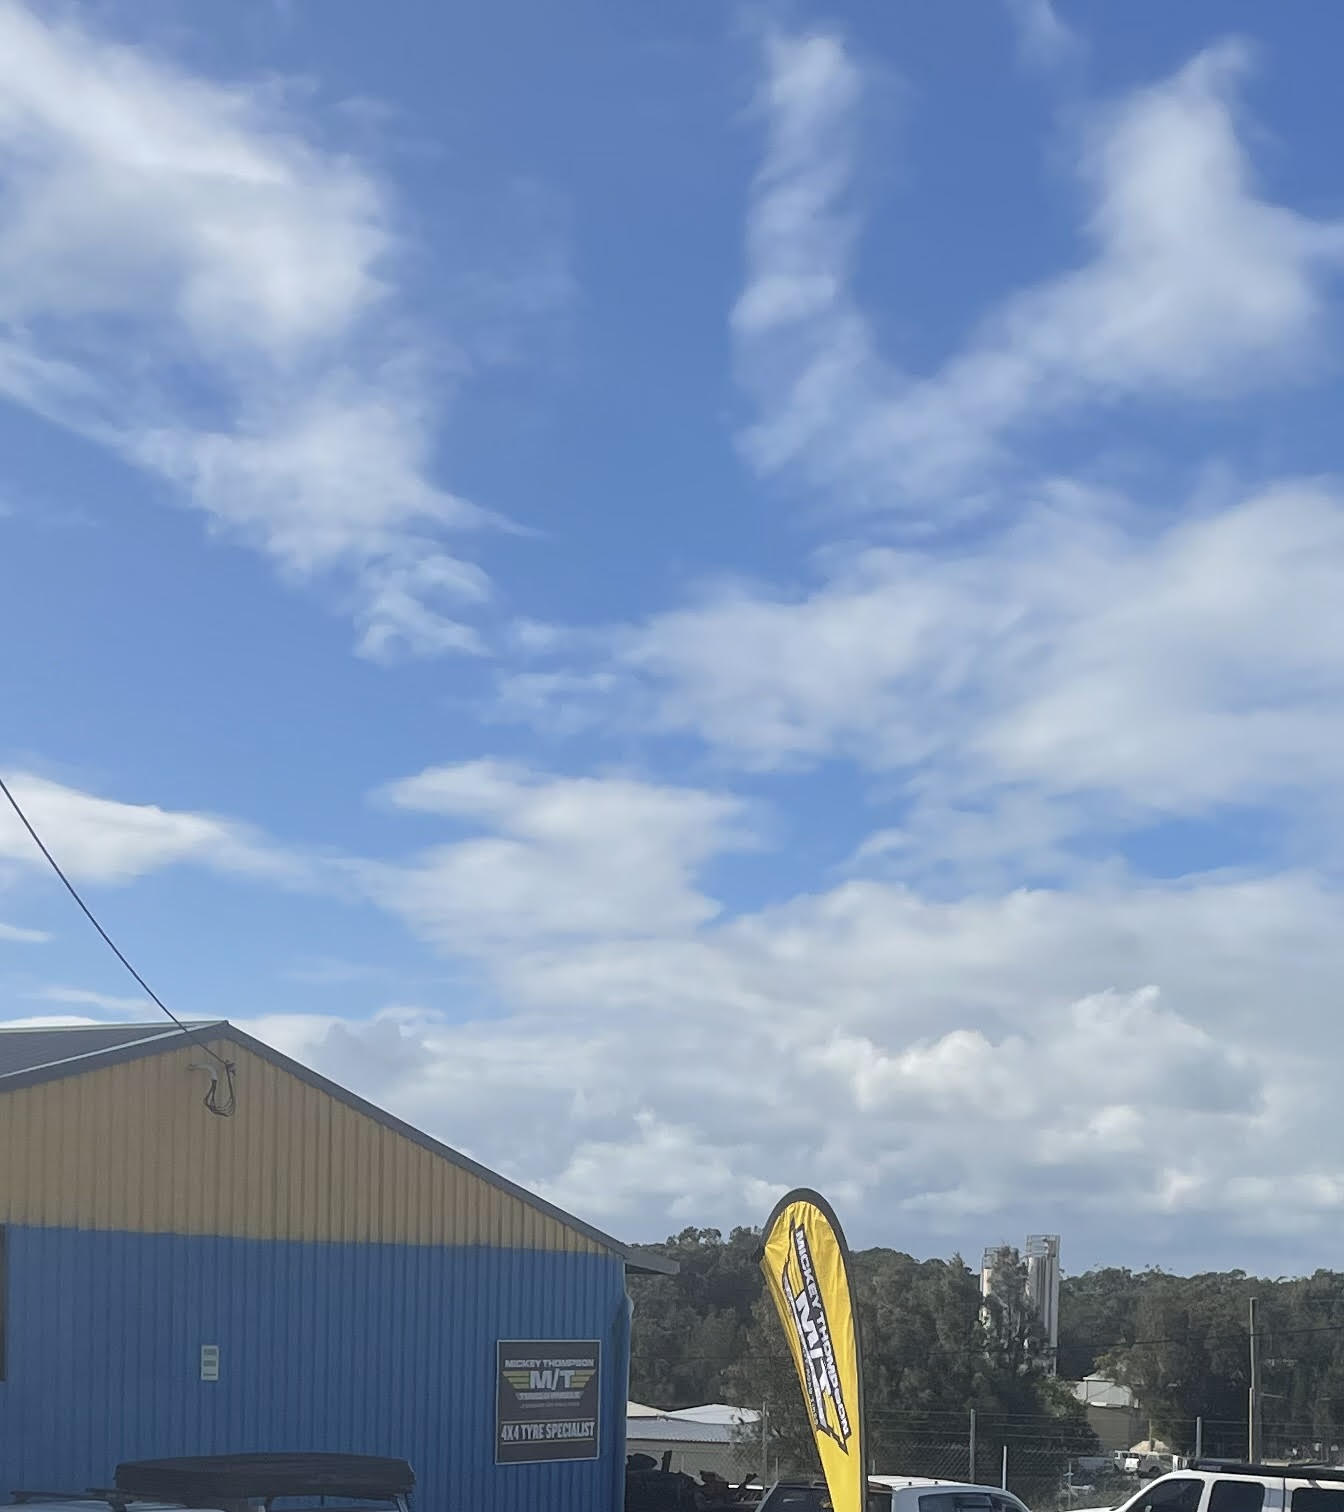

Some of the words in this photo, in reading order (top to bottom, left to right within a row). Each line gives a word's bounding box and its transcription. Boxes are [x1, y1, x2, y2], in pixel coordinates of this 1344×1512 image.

[795, 1229, 822, 1308] MICKEY
[504, 1359, 541, 1368] MICKEY
[542, 1358, 595, 1367] THOMPSON
[530, 1368, 575, 1391] M/T
[520, 1423, 545, 1440] TYRE
[545, 1421, 595, 1439] SPECIALIST
